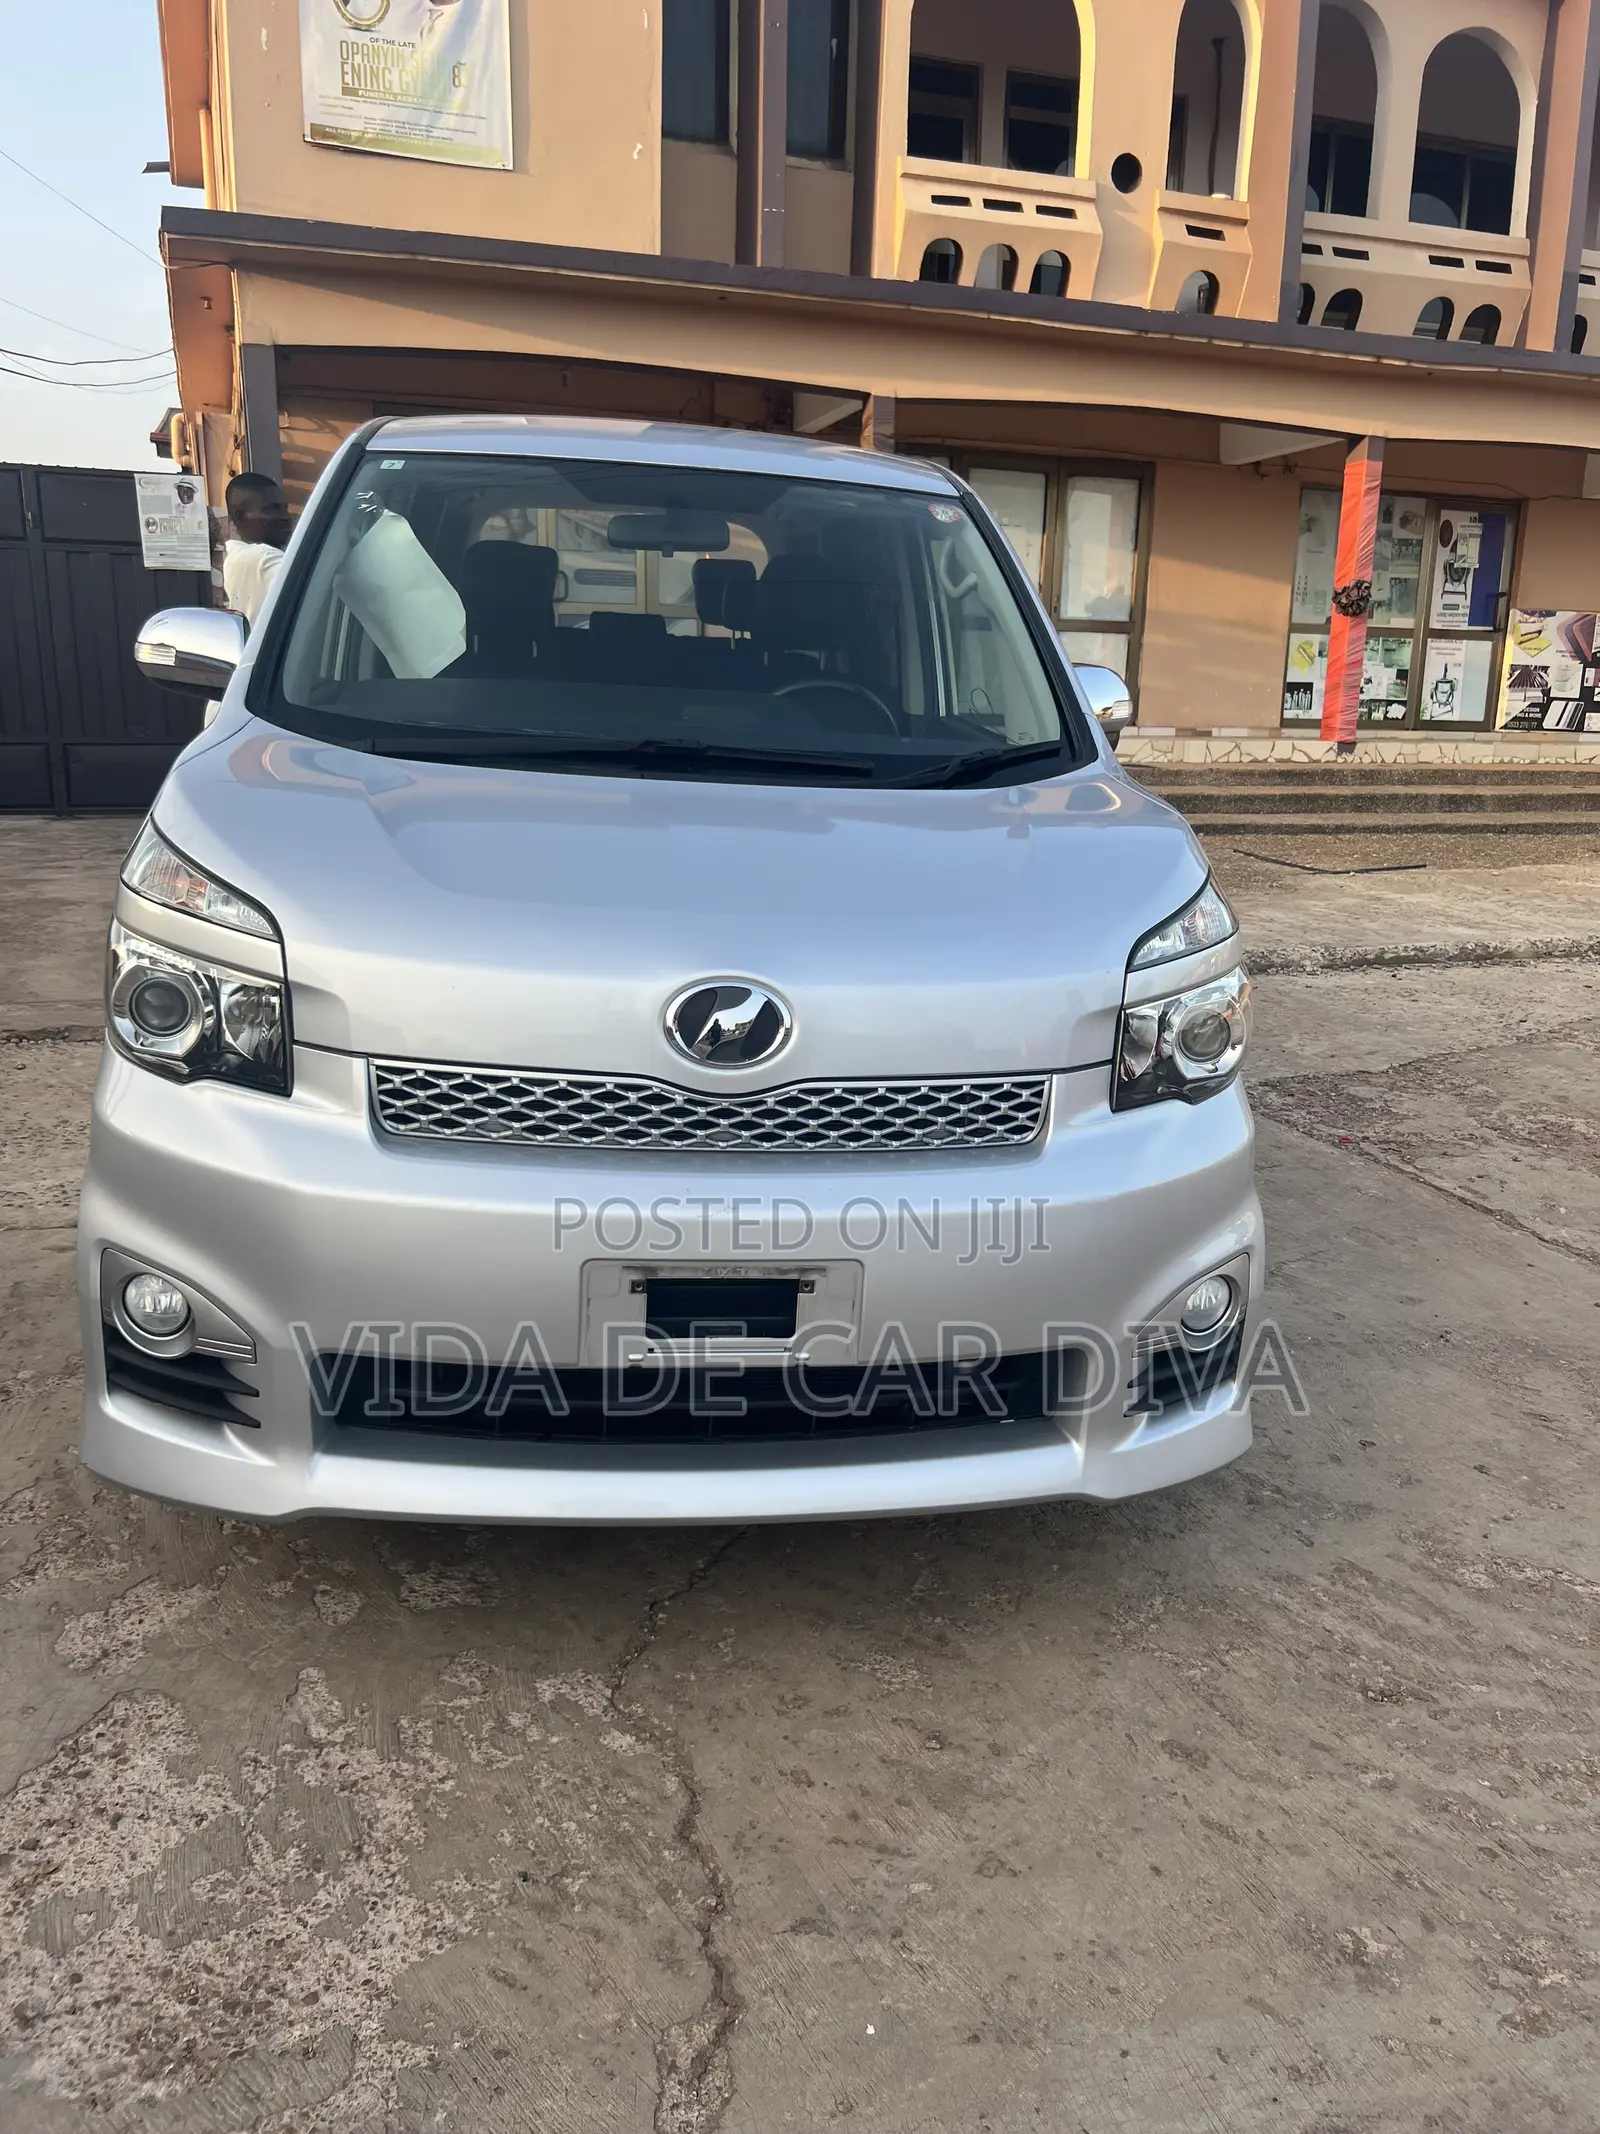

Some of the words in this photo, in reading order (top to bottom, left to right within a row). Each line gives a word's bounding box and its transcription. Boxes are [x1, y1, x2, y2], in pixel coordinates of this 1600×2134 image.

[382, 38, 396, 46] THE
[398, 41, 416, 49] LATE
[340, 40, 405, 69] OPANYIN
[358, 90, 396, 101] FUNERAL
